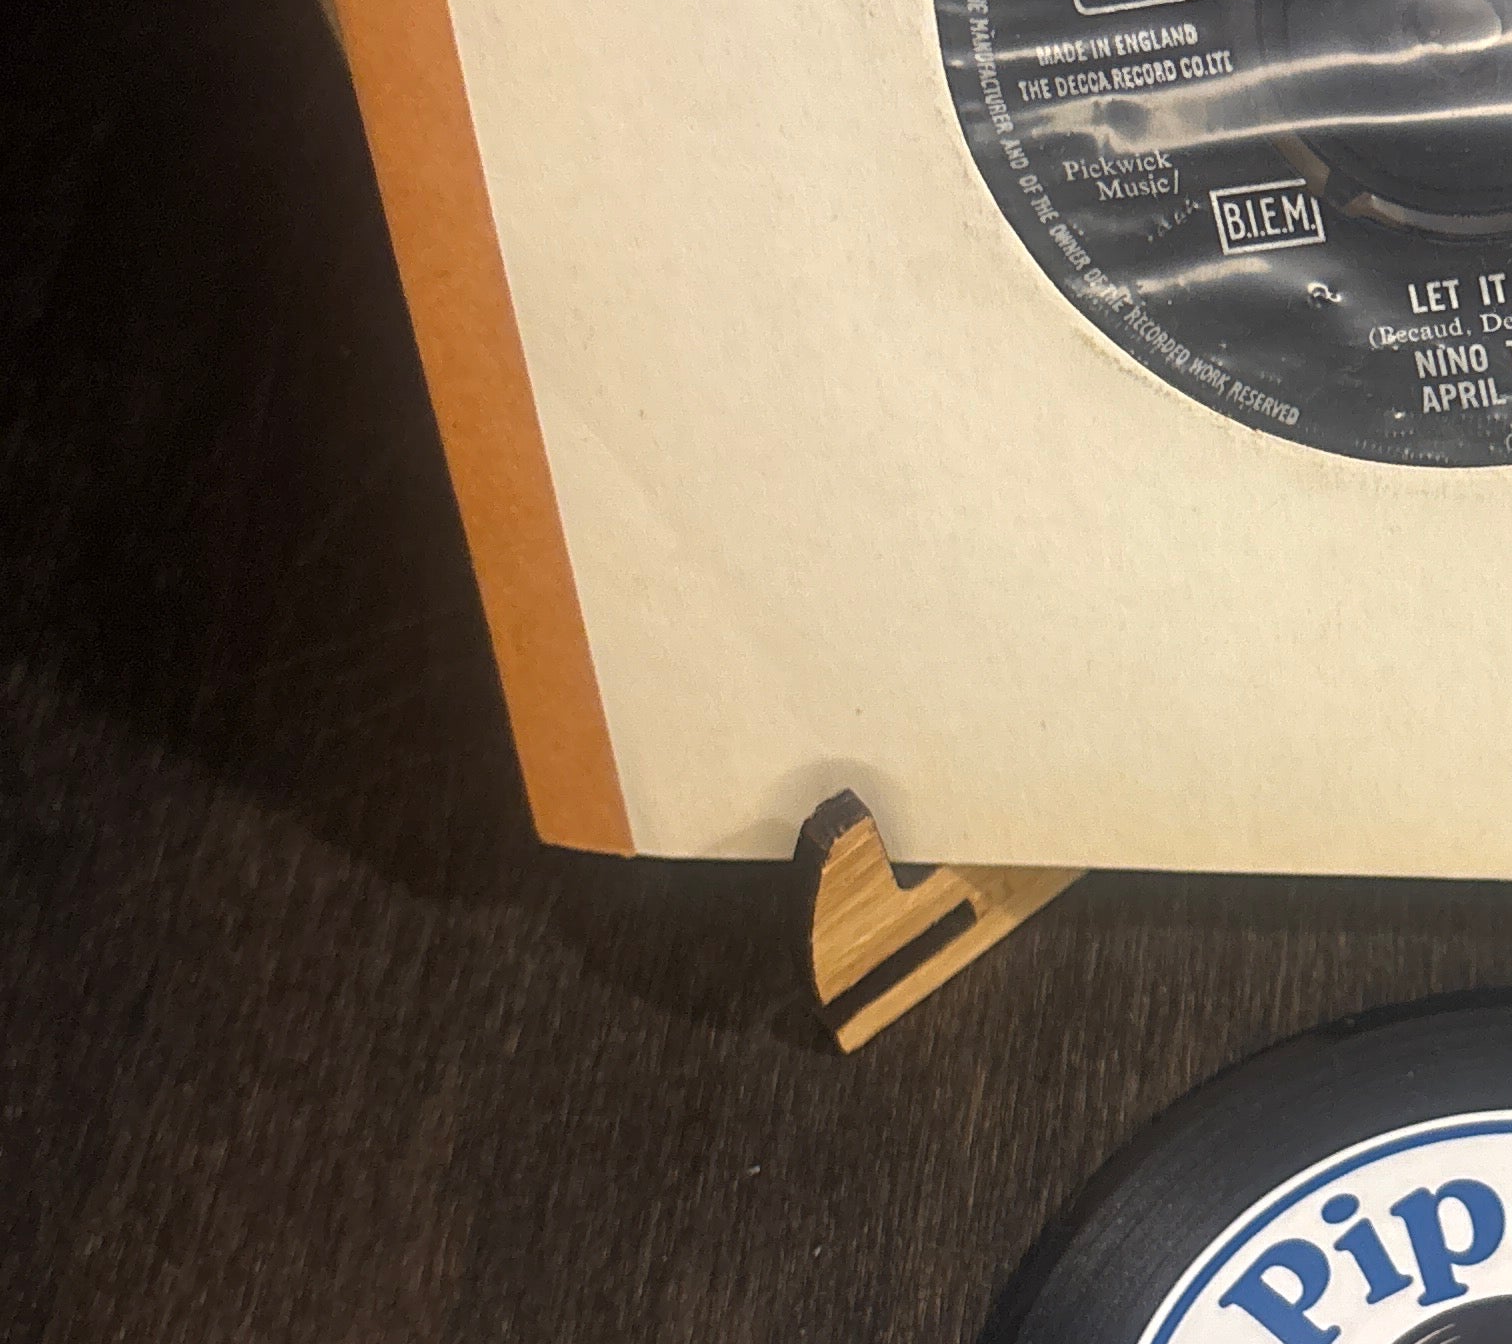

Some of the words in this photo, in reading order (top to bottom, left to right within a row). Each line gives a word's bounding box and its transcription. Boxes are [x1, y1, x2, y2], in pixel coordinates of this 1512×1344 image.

[1036, 40, 1088, 66] MADE
[1091, 37, 1112, 58] IN
[1115, 23, 1198, 56] ENGLAND
[1018, 78, 1051, 101] THE
[1055, 71, 1112, 97] DECCA
[1111, 59, 1176, 90] RECORD
[1062, 150, 1173, 181] Pickwick
[969, 17, 1014, 135] MANUFACTURER
[1000, 139, 1029, 170] AND
[1018, 174, 1044, 194] OF
[1031, 194, 1060, 224] THE
[1050, 223, 1091, 271] OWNER
[1123, 305, 1191, 367] RECORDED
[1189, 357, 1231, 395] WORK
[1228, 380, 1300, 426] RESERVED
[1223, 193, 1316, 241] B.I.E.M.
[1408, 279, 1460, 314] LET
[1479, 273, 1505, 306] IT
[1415, 343, 1489, 379] NINO
[1423, 377, 1507, 414] APRIL
